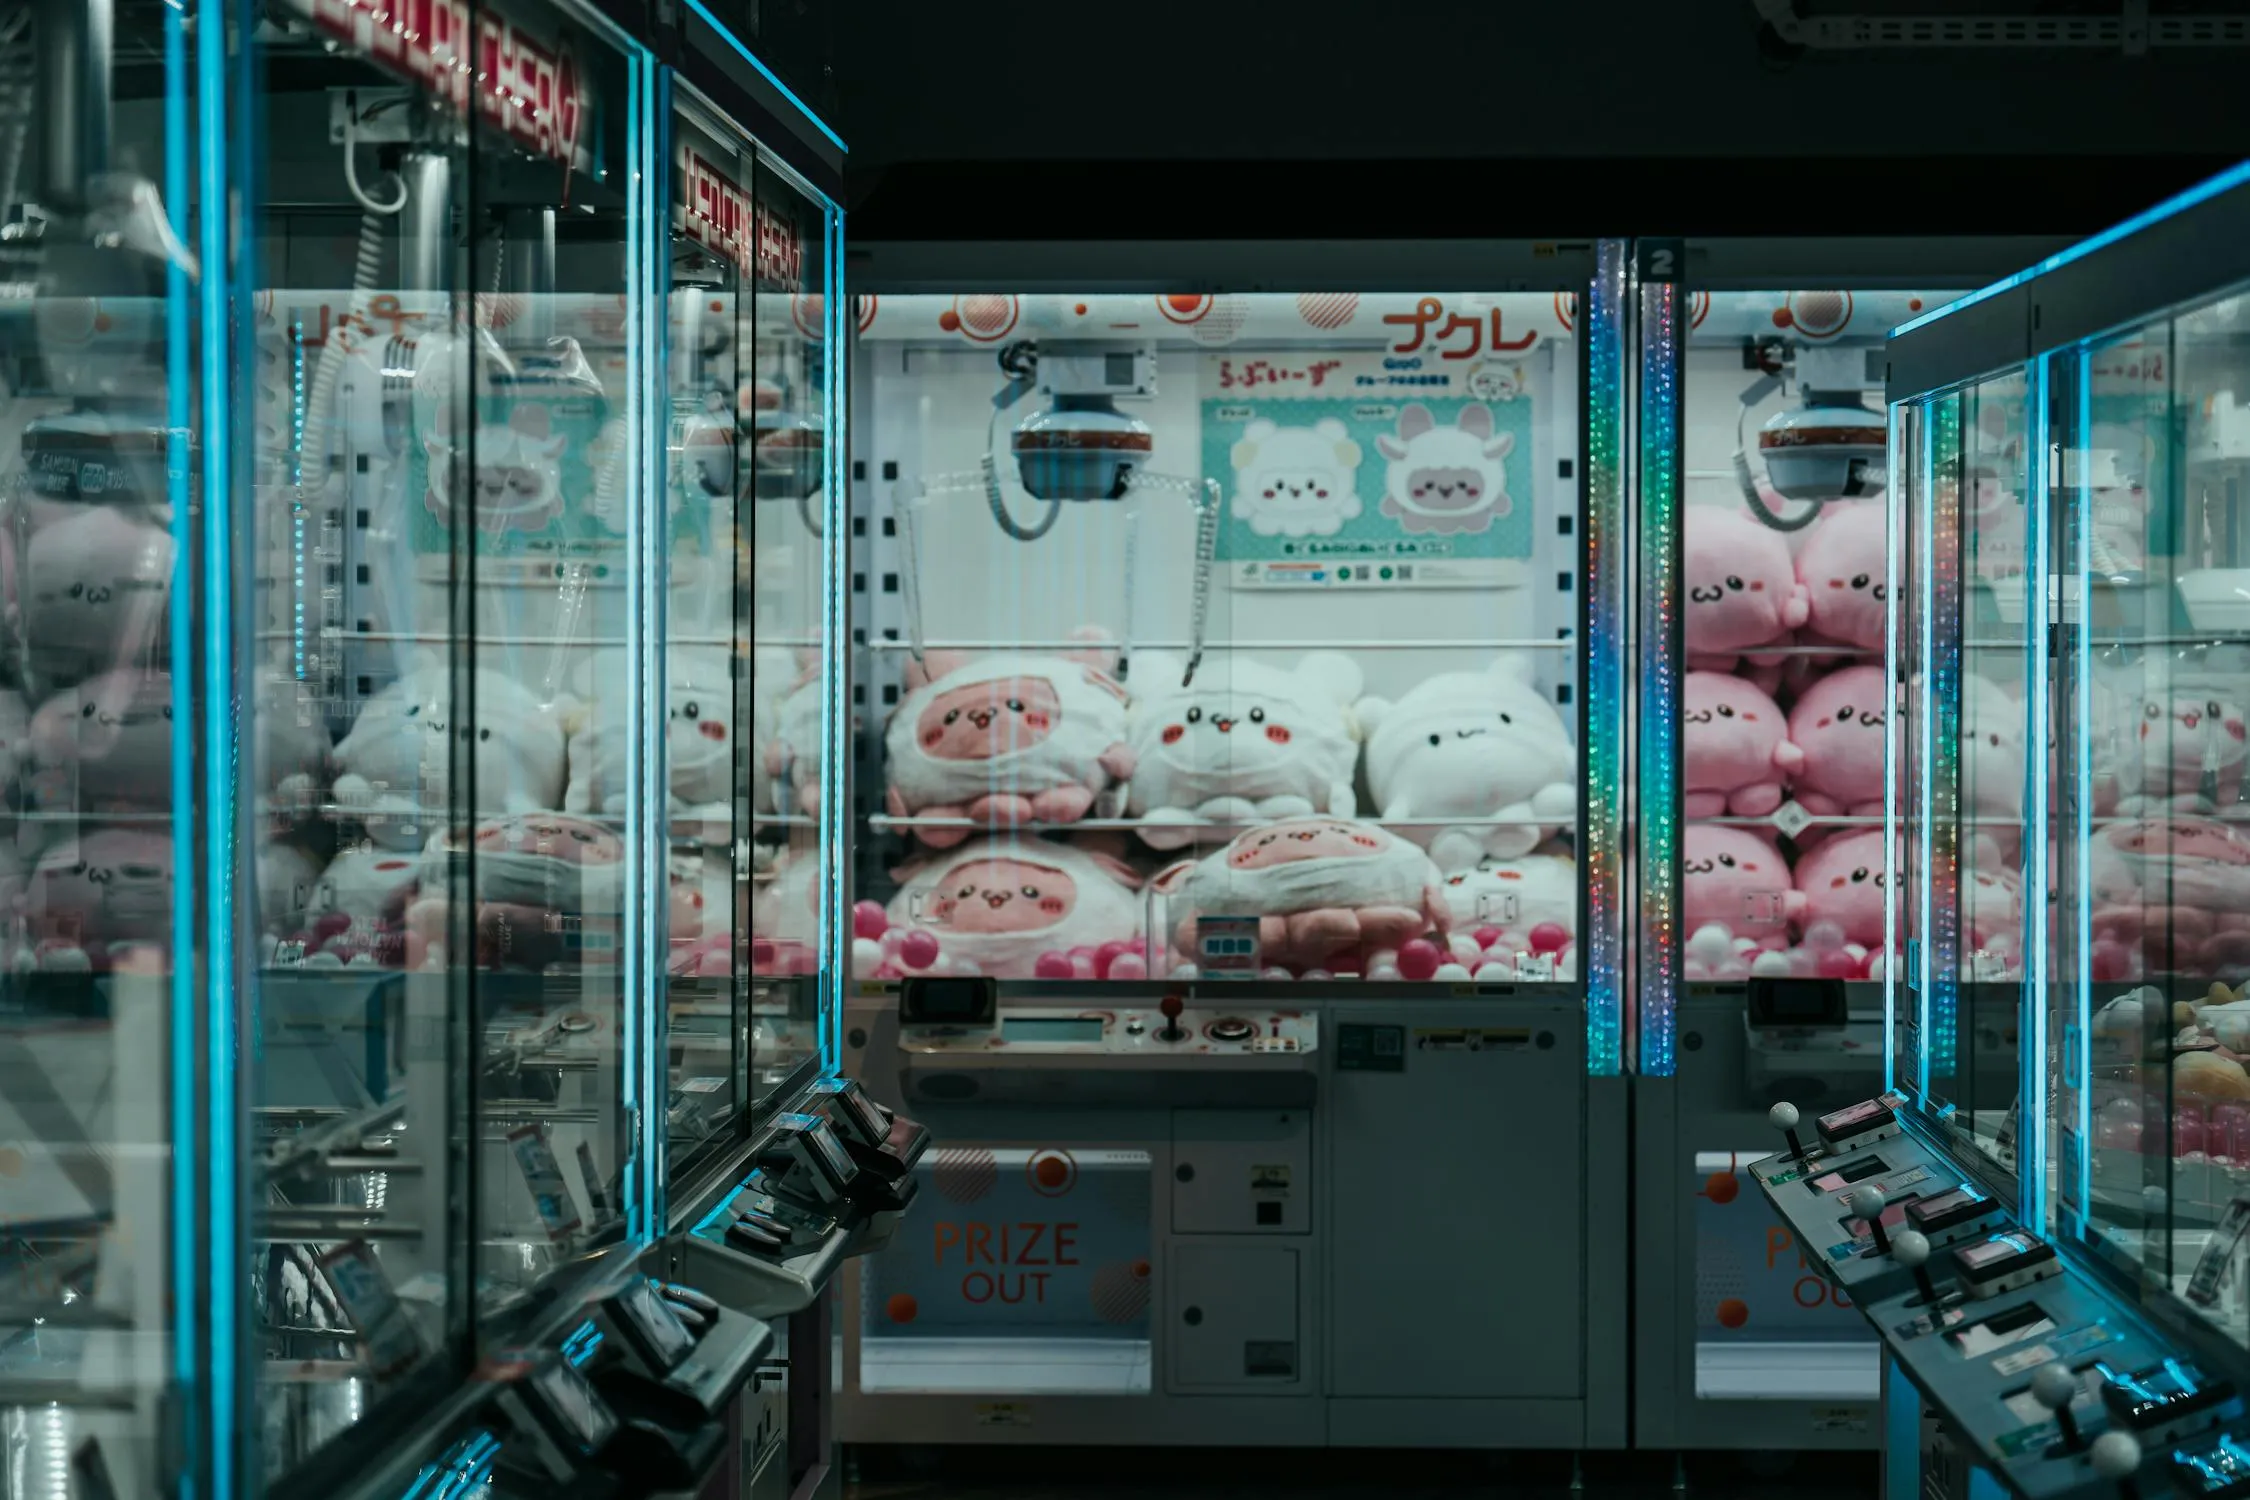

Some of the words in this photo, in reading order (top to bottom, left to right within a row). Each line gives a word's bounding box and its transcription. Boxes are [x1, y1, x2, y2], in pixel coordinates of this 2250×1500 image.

[1651, 250, 1674, 275] 2
[1383, 298, 1538, 360] プクレ
[934, 1221, 1079, 1266] PRIZE
[961, 1271, 1051, 1303] OUT
[1793, 1276, 1852, 1308] OU
